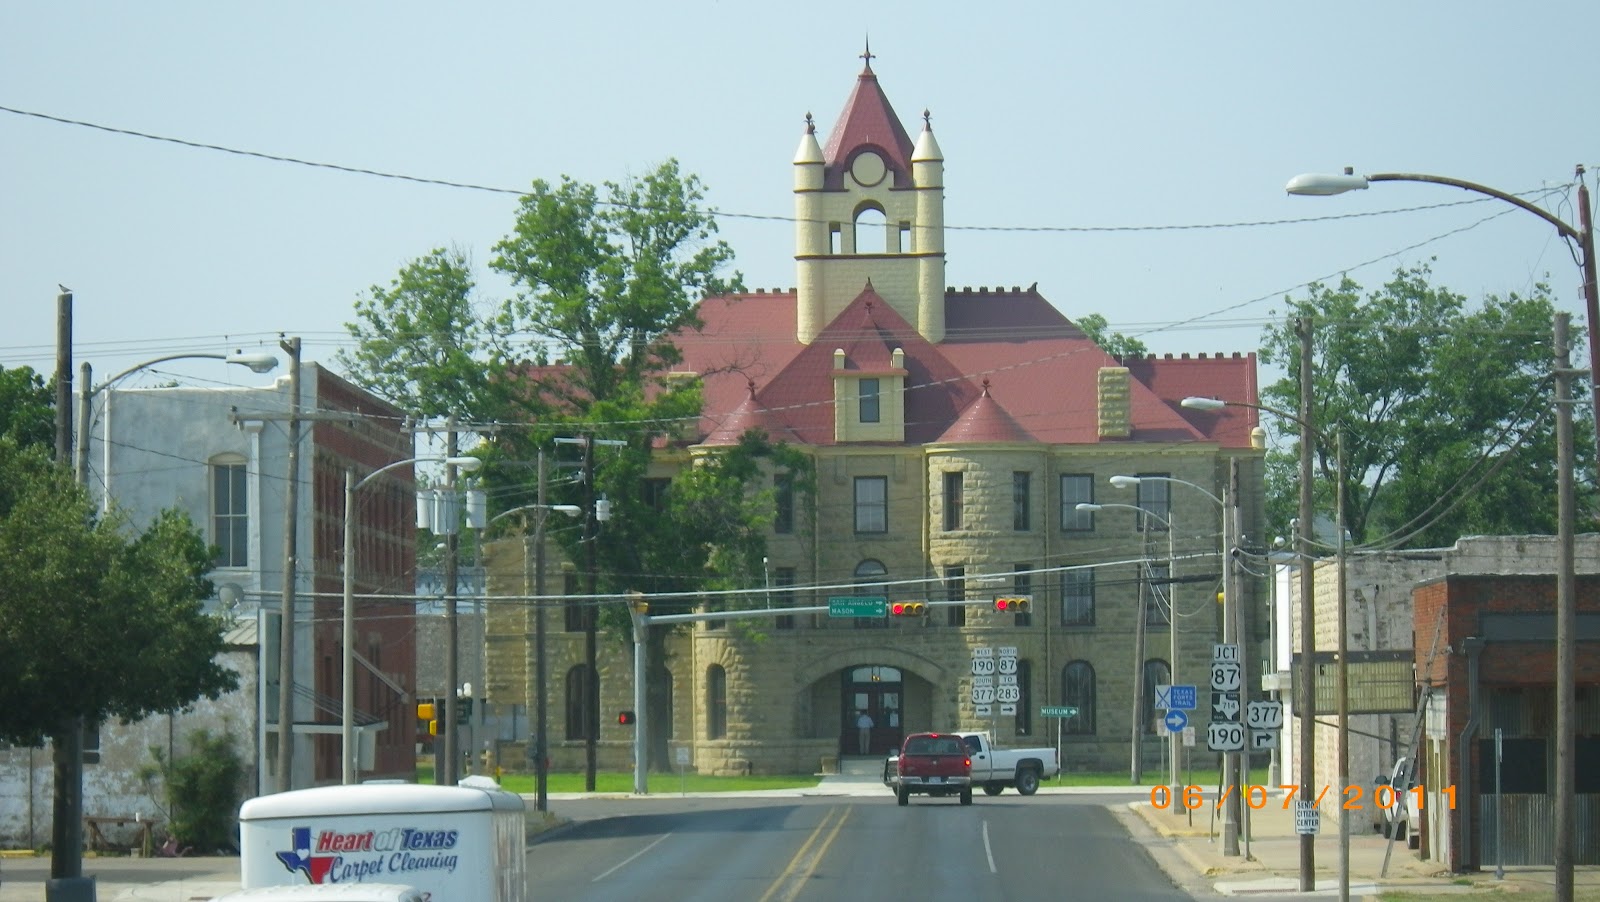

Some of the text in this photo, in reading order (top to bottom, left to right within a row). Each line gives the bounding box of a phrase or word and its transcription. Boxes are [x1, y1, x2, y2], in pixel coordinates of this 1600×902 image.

[1215, 647, 1237, 659] JCT
[974, 661, 993, 671] 190
[1000, 660, 1015, 670] 87
[1214, 668, 1237, 685] 87
[973, 690, 993, 700] 377
[998, 689, 1018, 699] 283
[1251, 706, 1279, 723] 377
[1211, 728, 1241, 744] 190
[1296, 819, 1319, 827] CENTER
[316, 828, 459, 853] Heart of Texas
[329, 852, 458, 883] Carpet Cleaning
